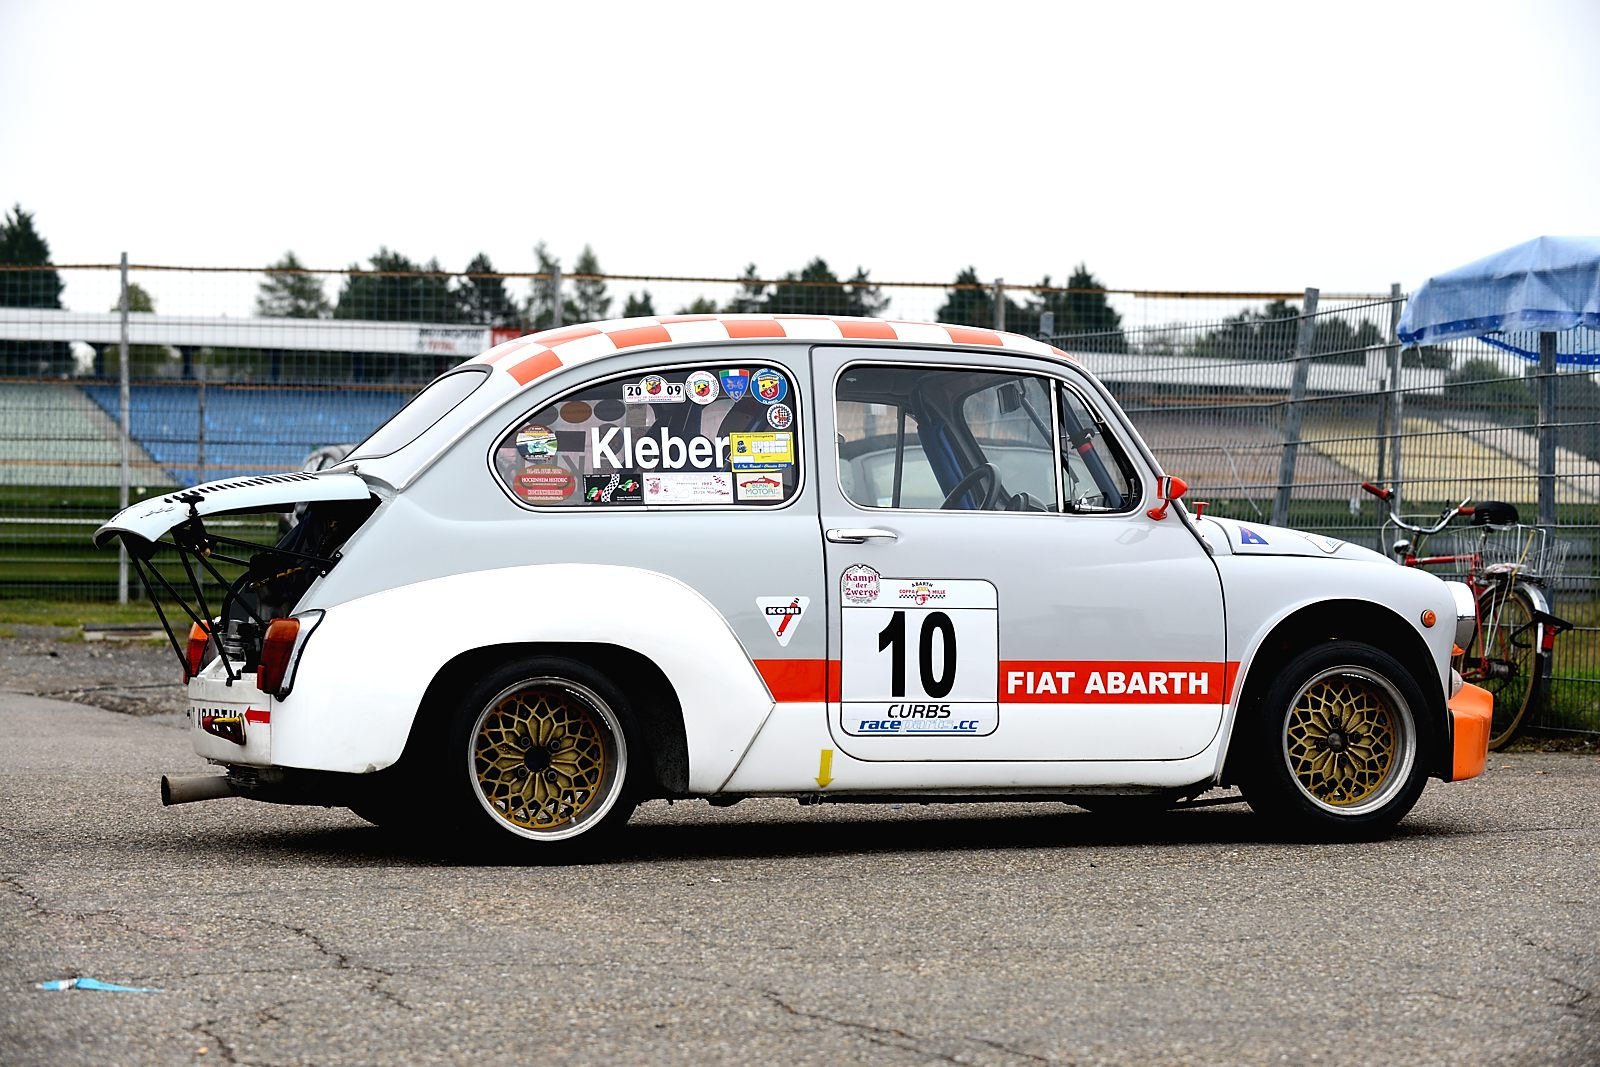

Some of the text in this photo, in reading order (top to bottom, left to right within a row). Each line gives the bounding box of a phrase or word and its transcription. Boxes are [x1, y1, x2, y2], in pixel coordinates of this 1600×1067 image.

[627, 385, 681, 396] 20 09
[591, 427, 729, 469] Kleber
[846, 573, 877, 583] Kampf
[845, 588, 878, 597] Zwerge
[878, 611, 957, 699] 10
[1007, 671, 1209, 695] FIAT ABARTH
[887, 704, 951, 719] CURBS
